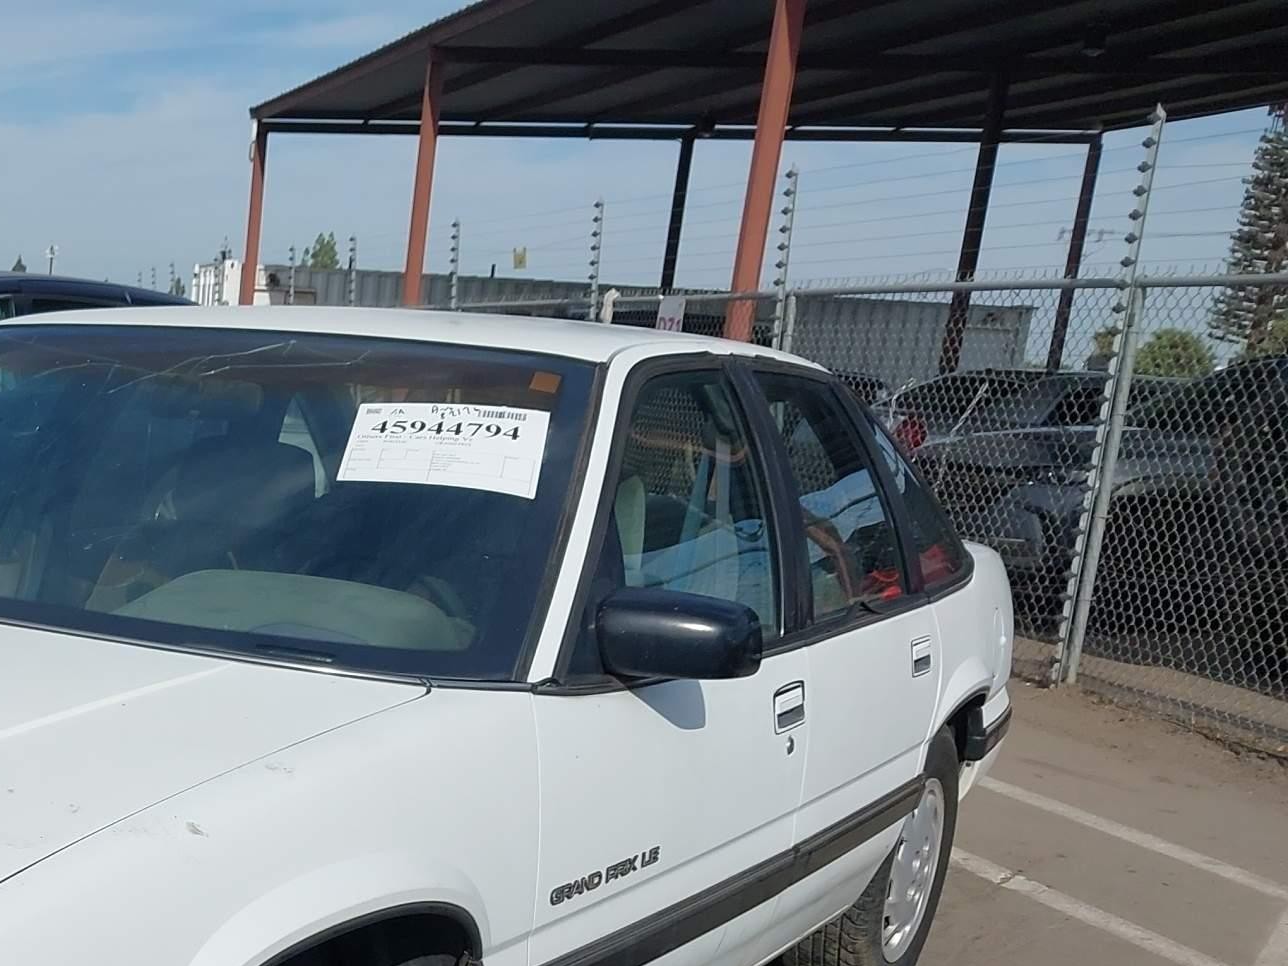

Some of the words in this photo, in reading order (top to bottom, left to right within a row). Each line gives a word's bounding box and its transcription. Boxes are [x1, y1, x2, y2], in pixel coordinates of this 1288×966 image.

[371, 420, 520, 441] 45944794
[550, 870, 603, 906] GRAND
[605, 854, 639, 884] PRIX
[641, 846, 660, 868] LE
